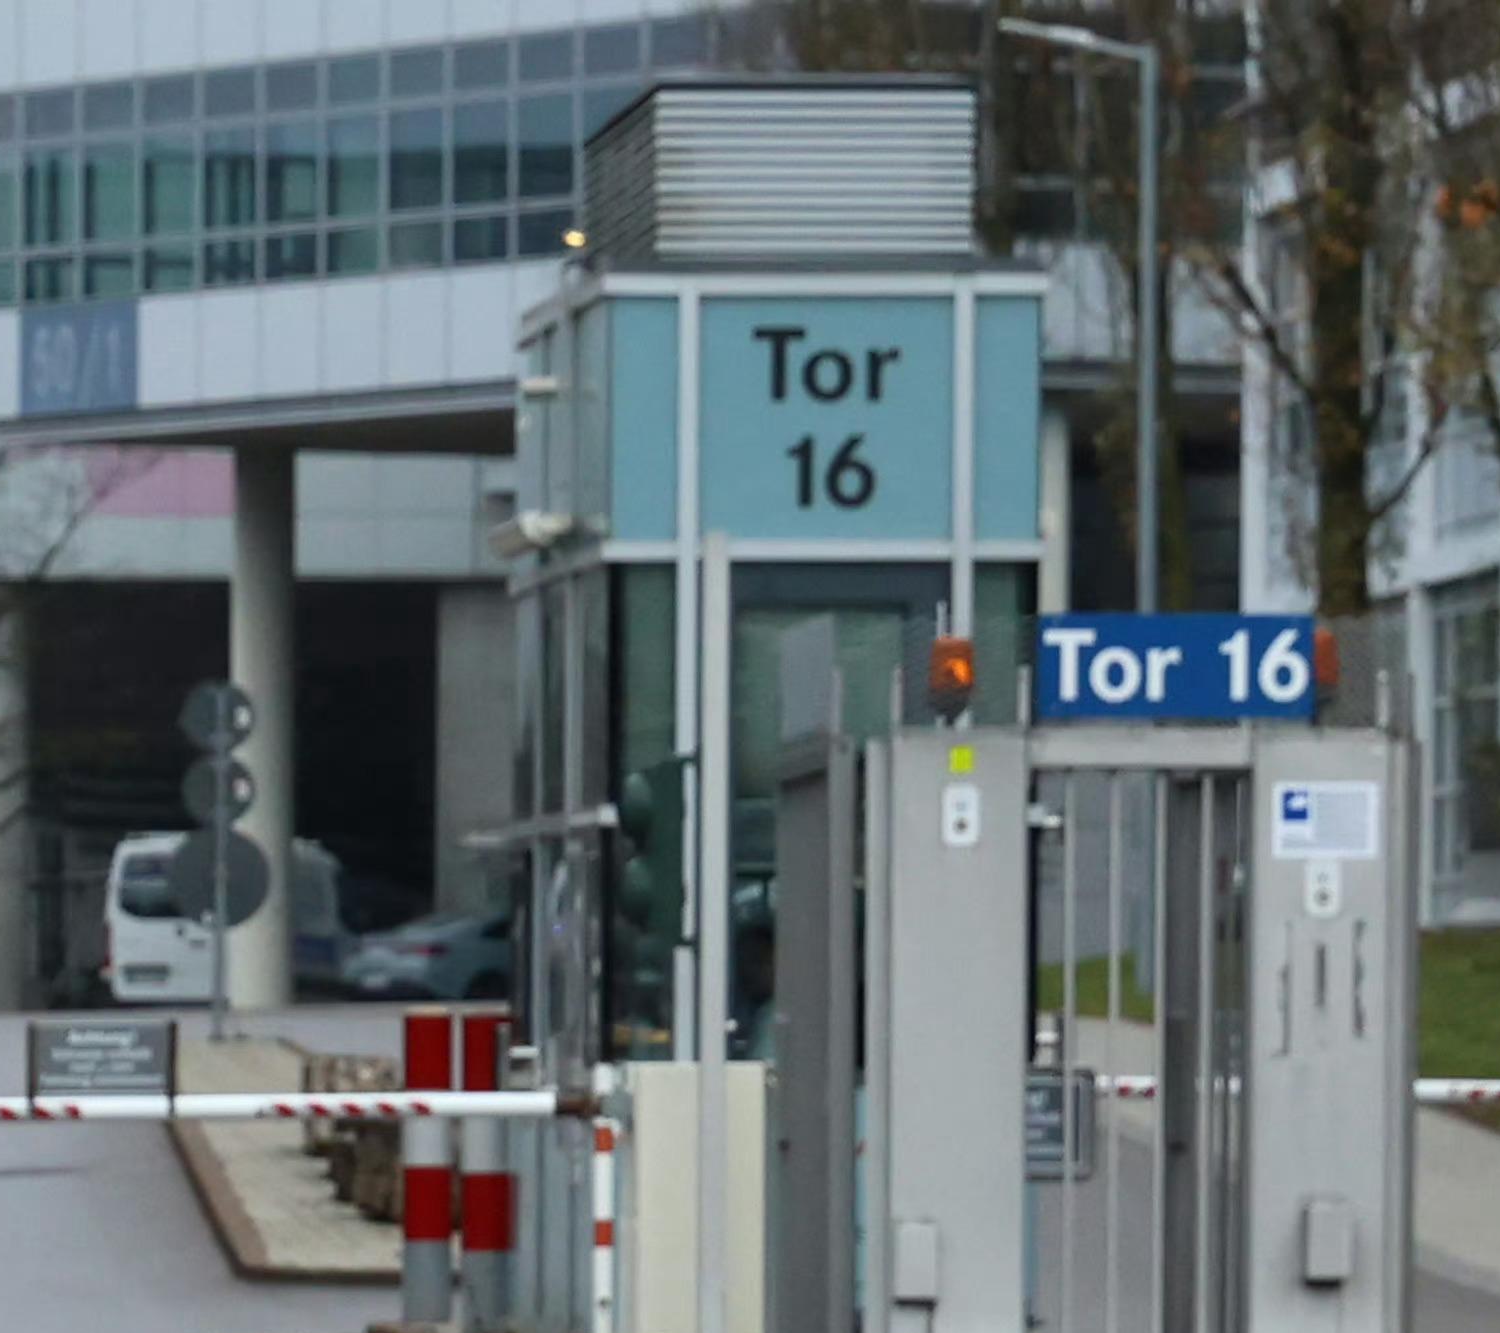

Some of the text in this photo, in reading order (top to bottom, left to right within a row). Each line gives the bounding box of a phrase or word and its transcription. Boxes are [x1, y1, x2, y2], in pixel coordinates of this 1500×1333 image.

[753, 326, 900, 402] Tor
[786, 432, 877, 508] 16
[1042, 627, 1311, 702] Tor 16
